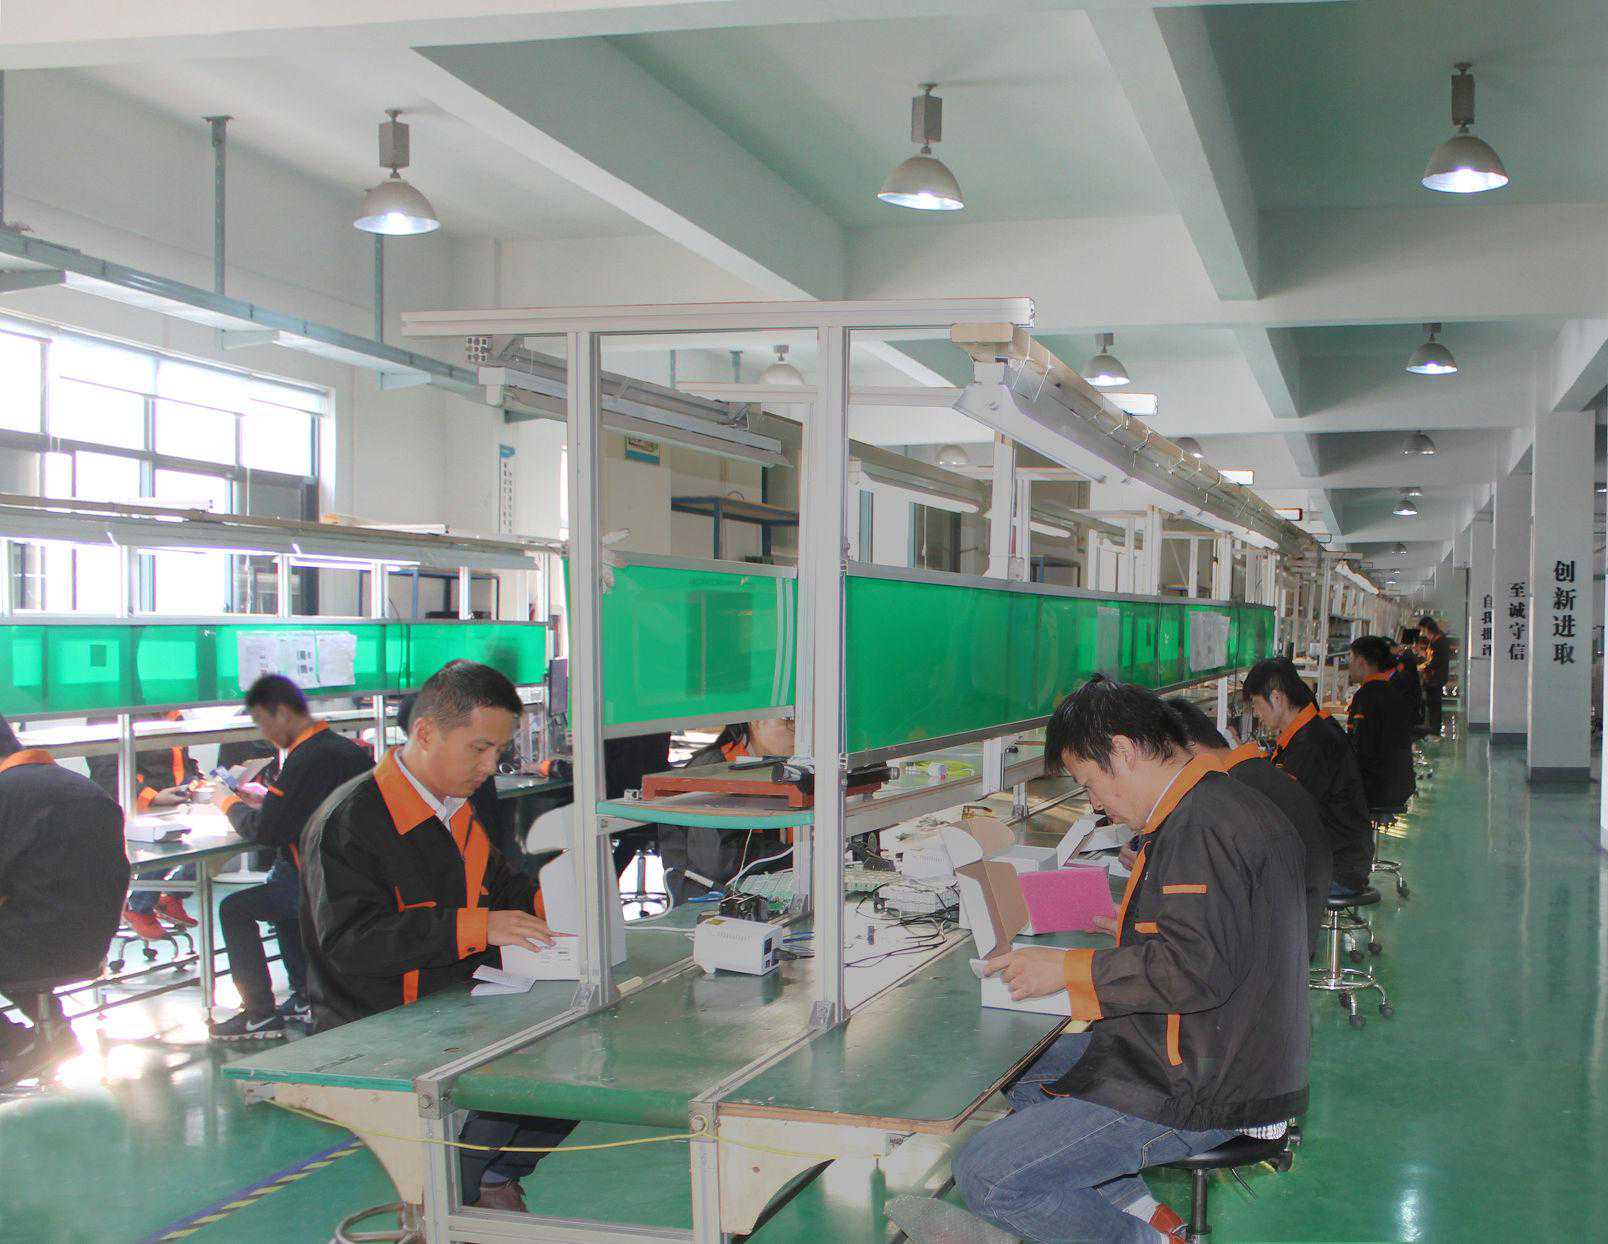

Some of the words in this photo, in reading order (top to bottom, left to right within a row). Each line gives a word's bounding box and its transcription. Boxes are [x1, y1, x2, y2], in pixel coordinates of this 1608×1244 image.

[1508, 581, 1527, 661] 至诚守信
[1552, 560, 1577, 665] 创新进取
